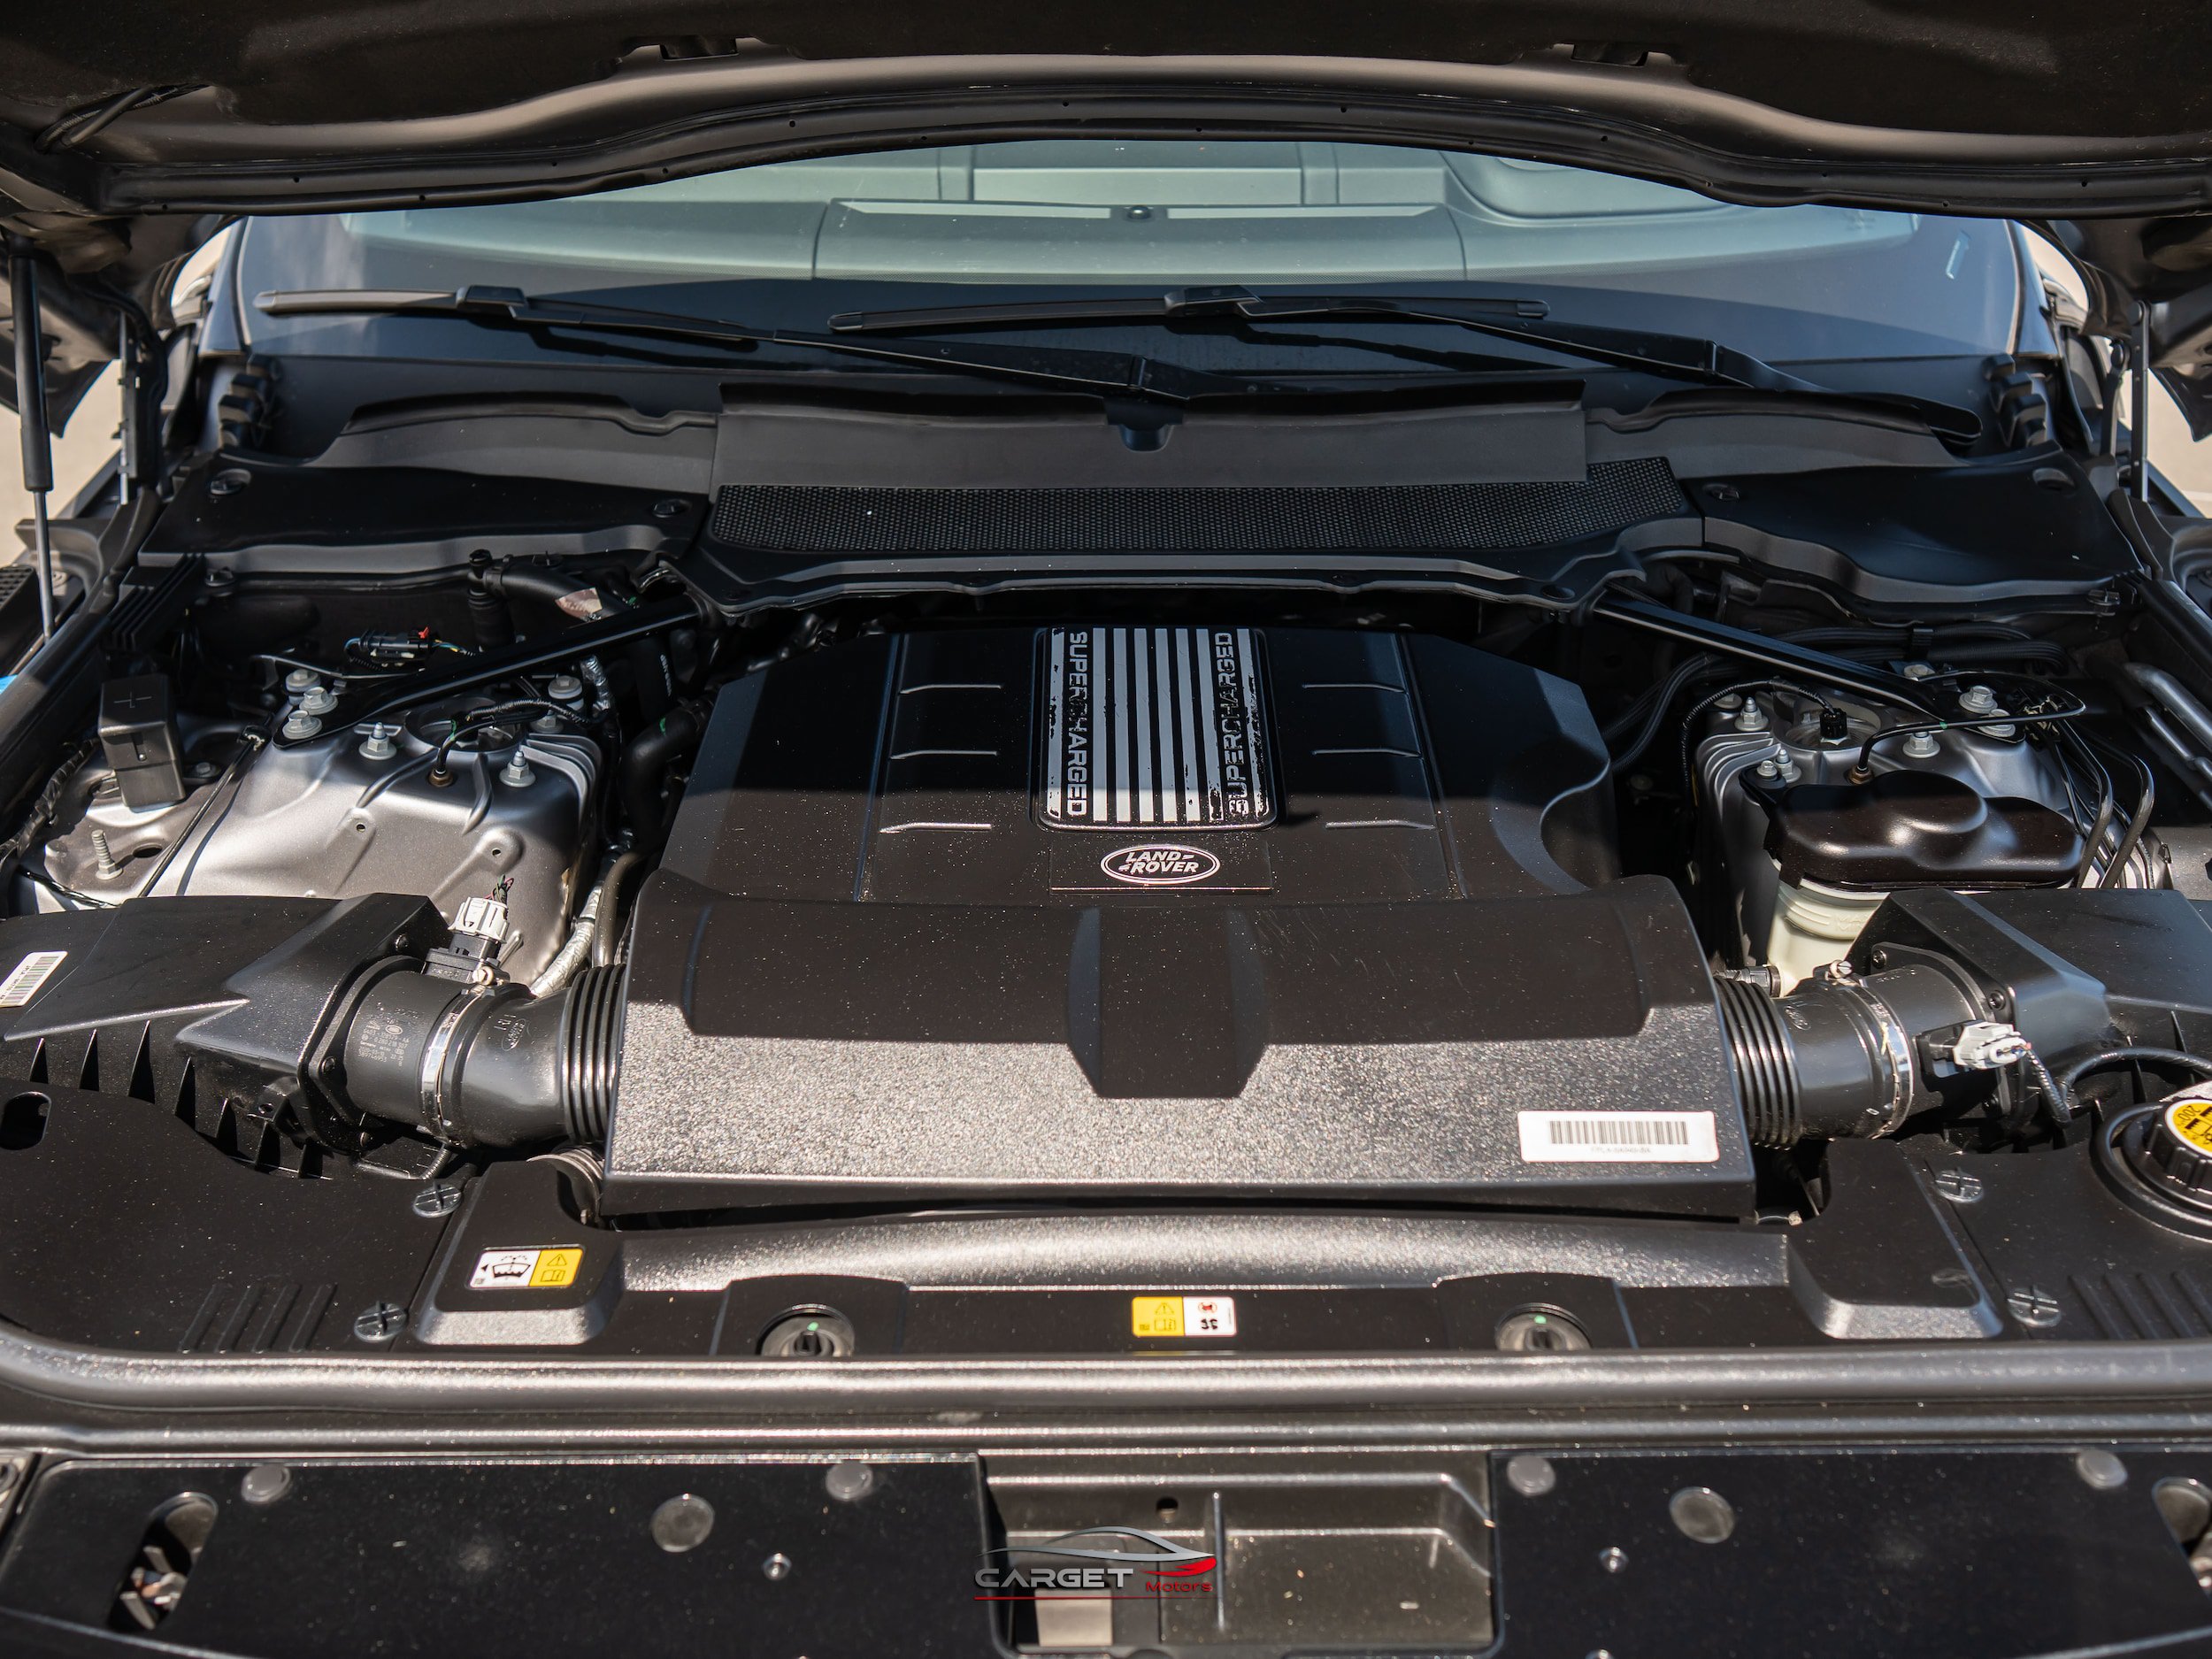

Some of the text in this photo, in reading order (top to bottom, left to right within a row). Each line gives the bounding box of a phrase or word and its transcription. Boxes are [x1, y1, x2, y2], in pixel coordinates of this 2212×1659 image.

[1214, 632, 1249, 817] SUPERCHARGED
[1125, 851, 1182, 863] LAND
[1130, 861, 1200, 872] ROVER
[2177, 1104, 2200, 1120] 200
